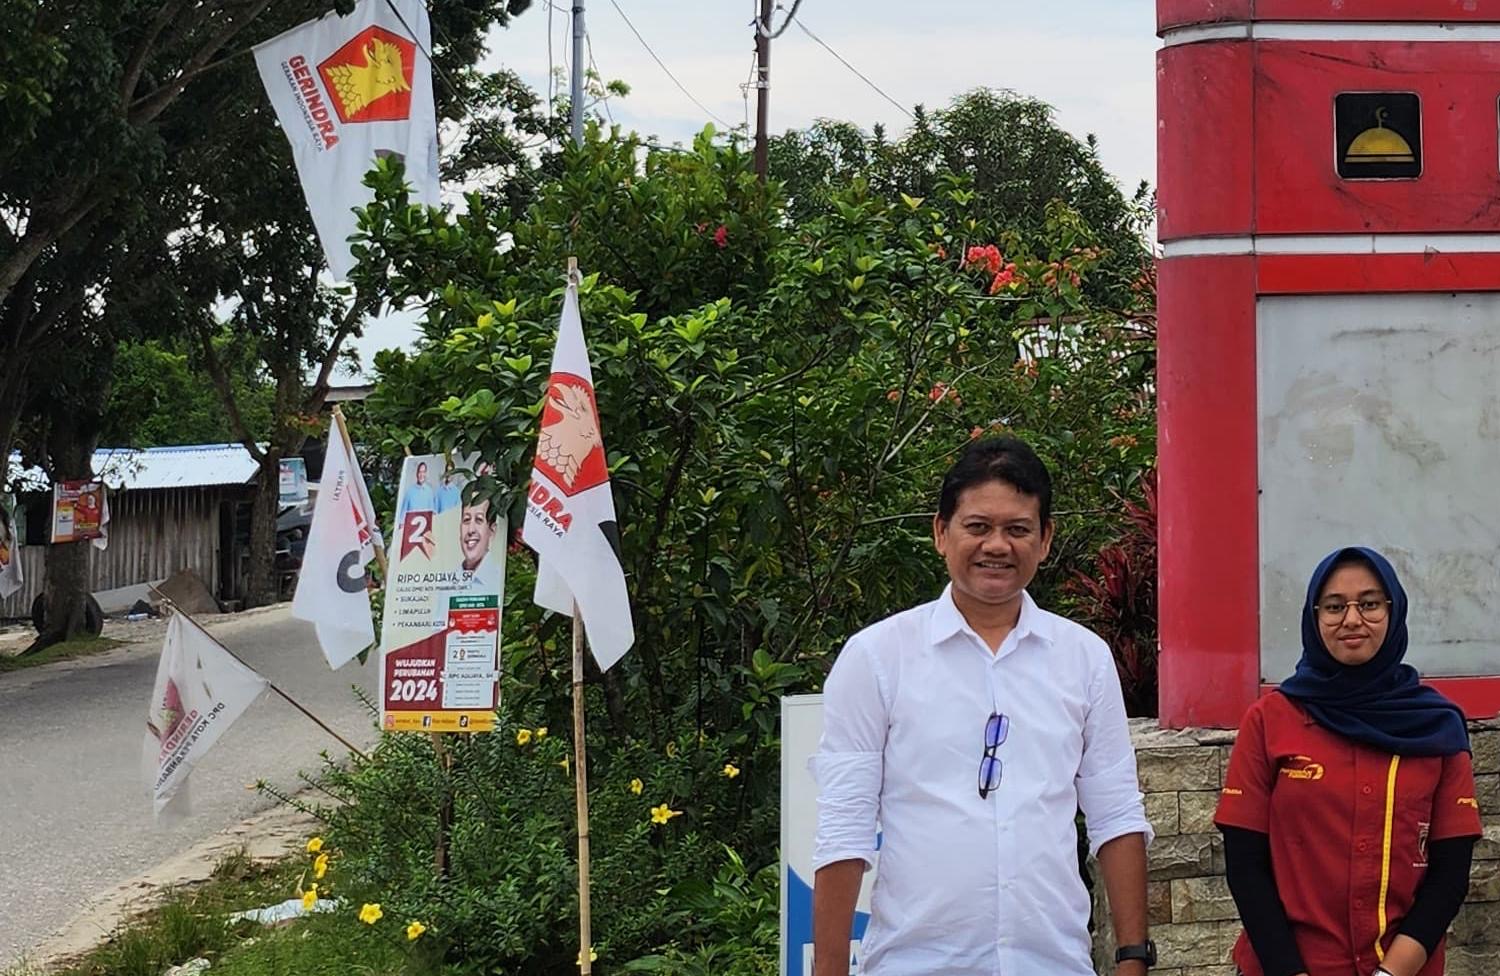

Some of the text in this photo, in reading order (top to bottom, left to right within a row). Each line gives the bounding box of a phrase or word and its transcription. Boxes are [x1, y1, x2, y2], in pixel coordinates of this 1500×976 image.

[288, 55, 340, 151] GERINDRA
[409, 516, 427, 543] 2
[543, 516, 564, 538] RAYA
[397, 574, 421, 583] RIPO
[395, 659, 437, 667] WUJUDKAN
[389, 679, 438, 702] 2024
